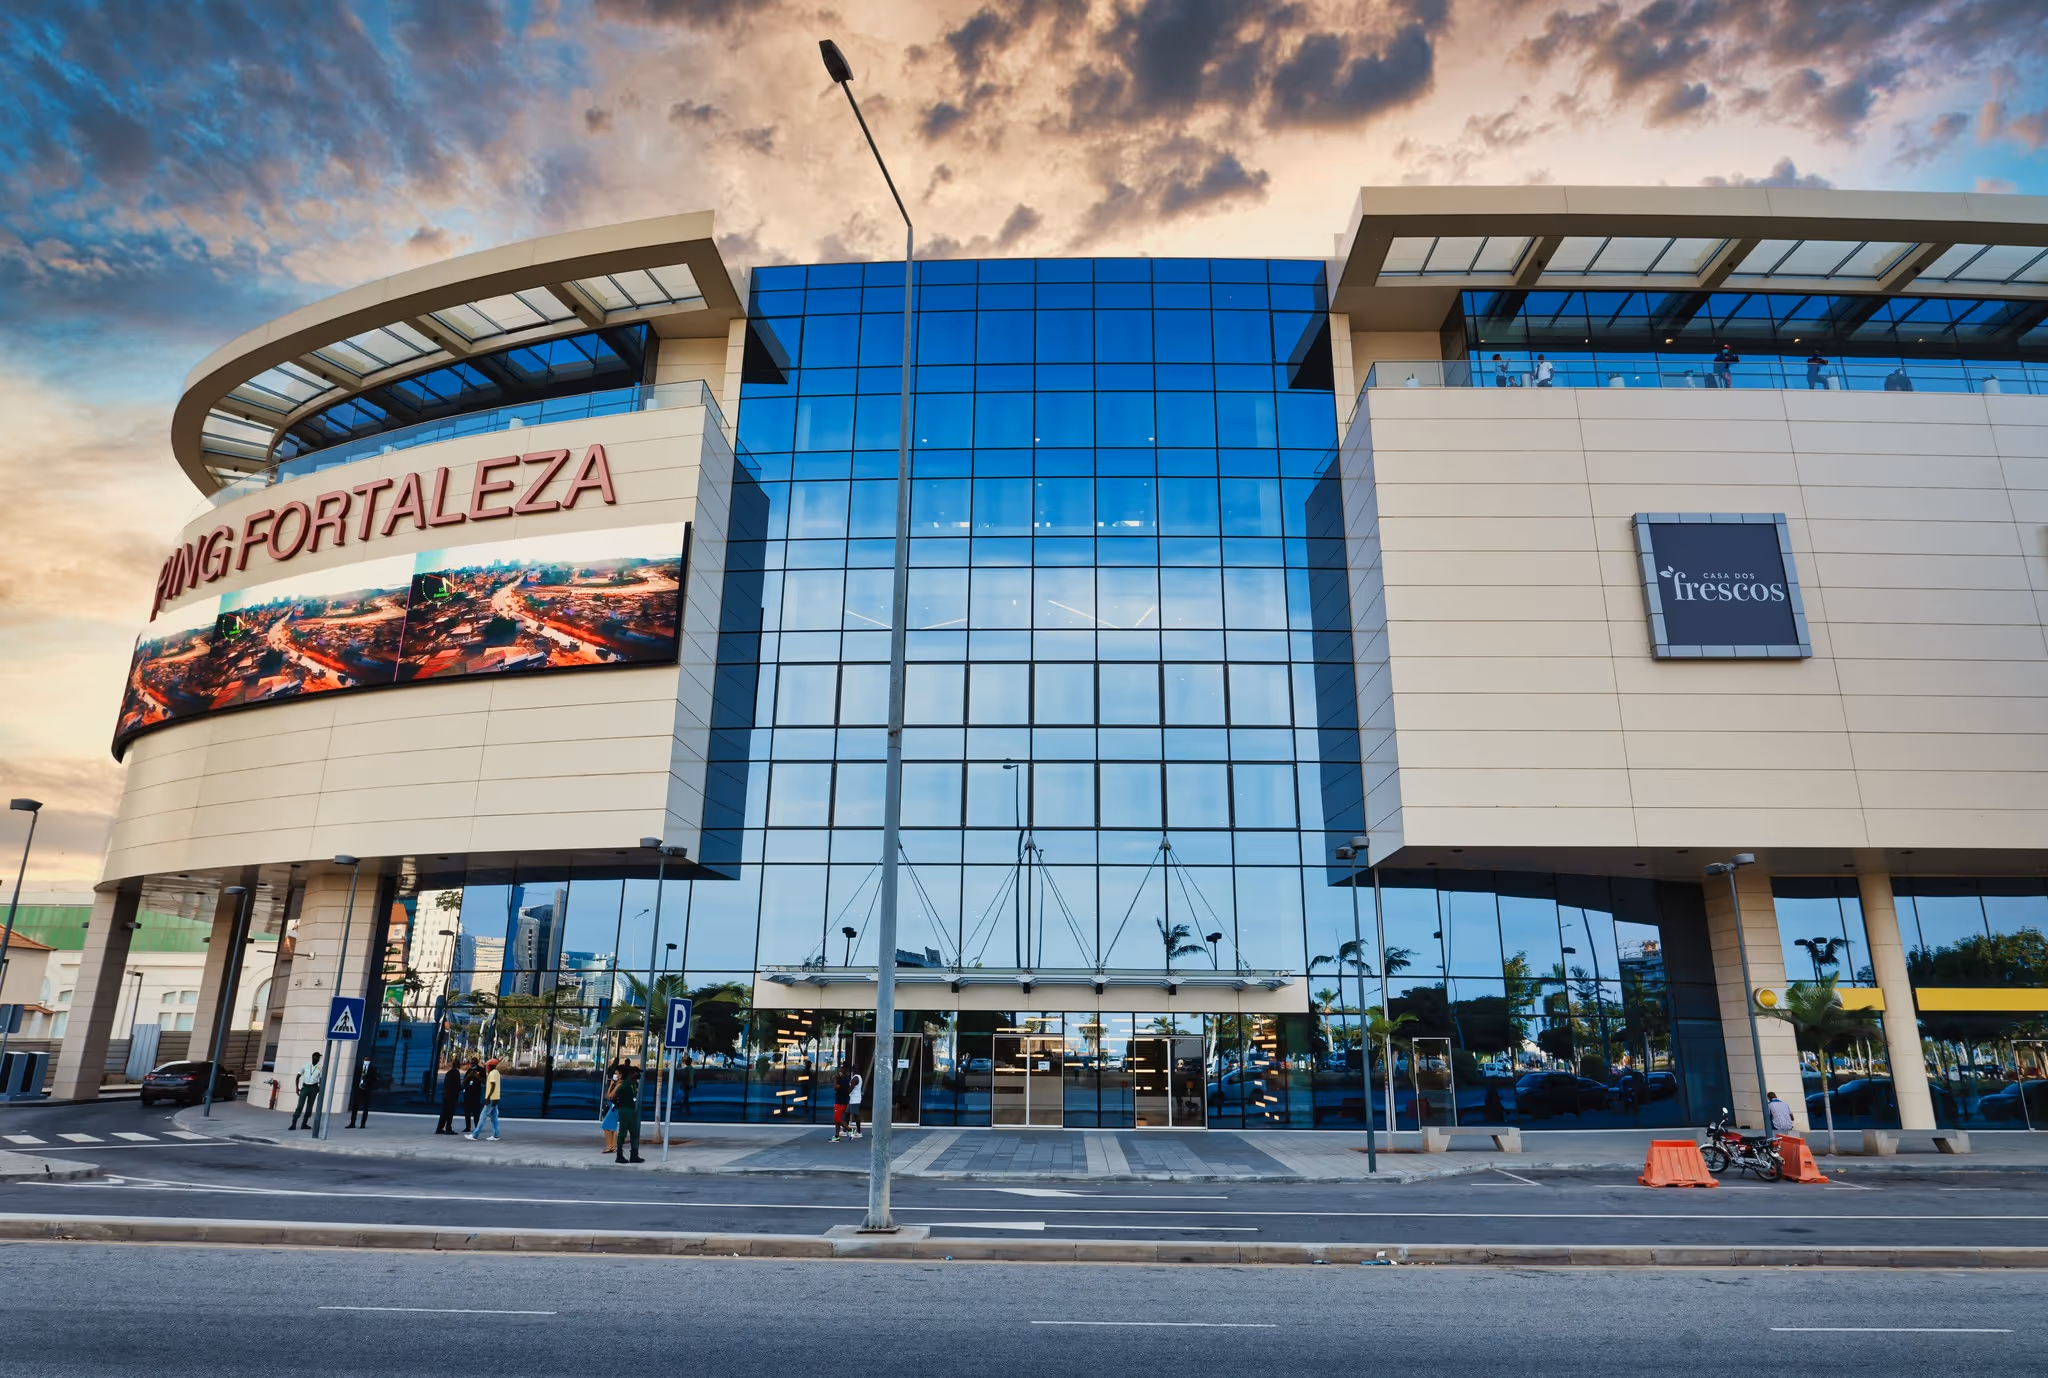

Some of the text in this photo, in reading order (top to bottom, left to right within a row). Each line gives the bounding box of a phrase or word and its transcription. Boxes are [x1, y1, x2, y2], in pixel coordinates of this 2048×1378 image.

[236, 443, 617, 571] FORTALEZA
[1673, 571, 1785, 602] frescos
[671, 1003, 687, 1043] P
